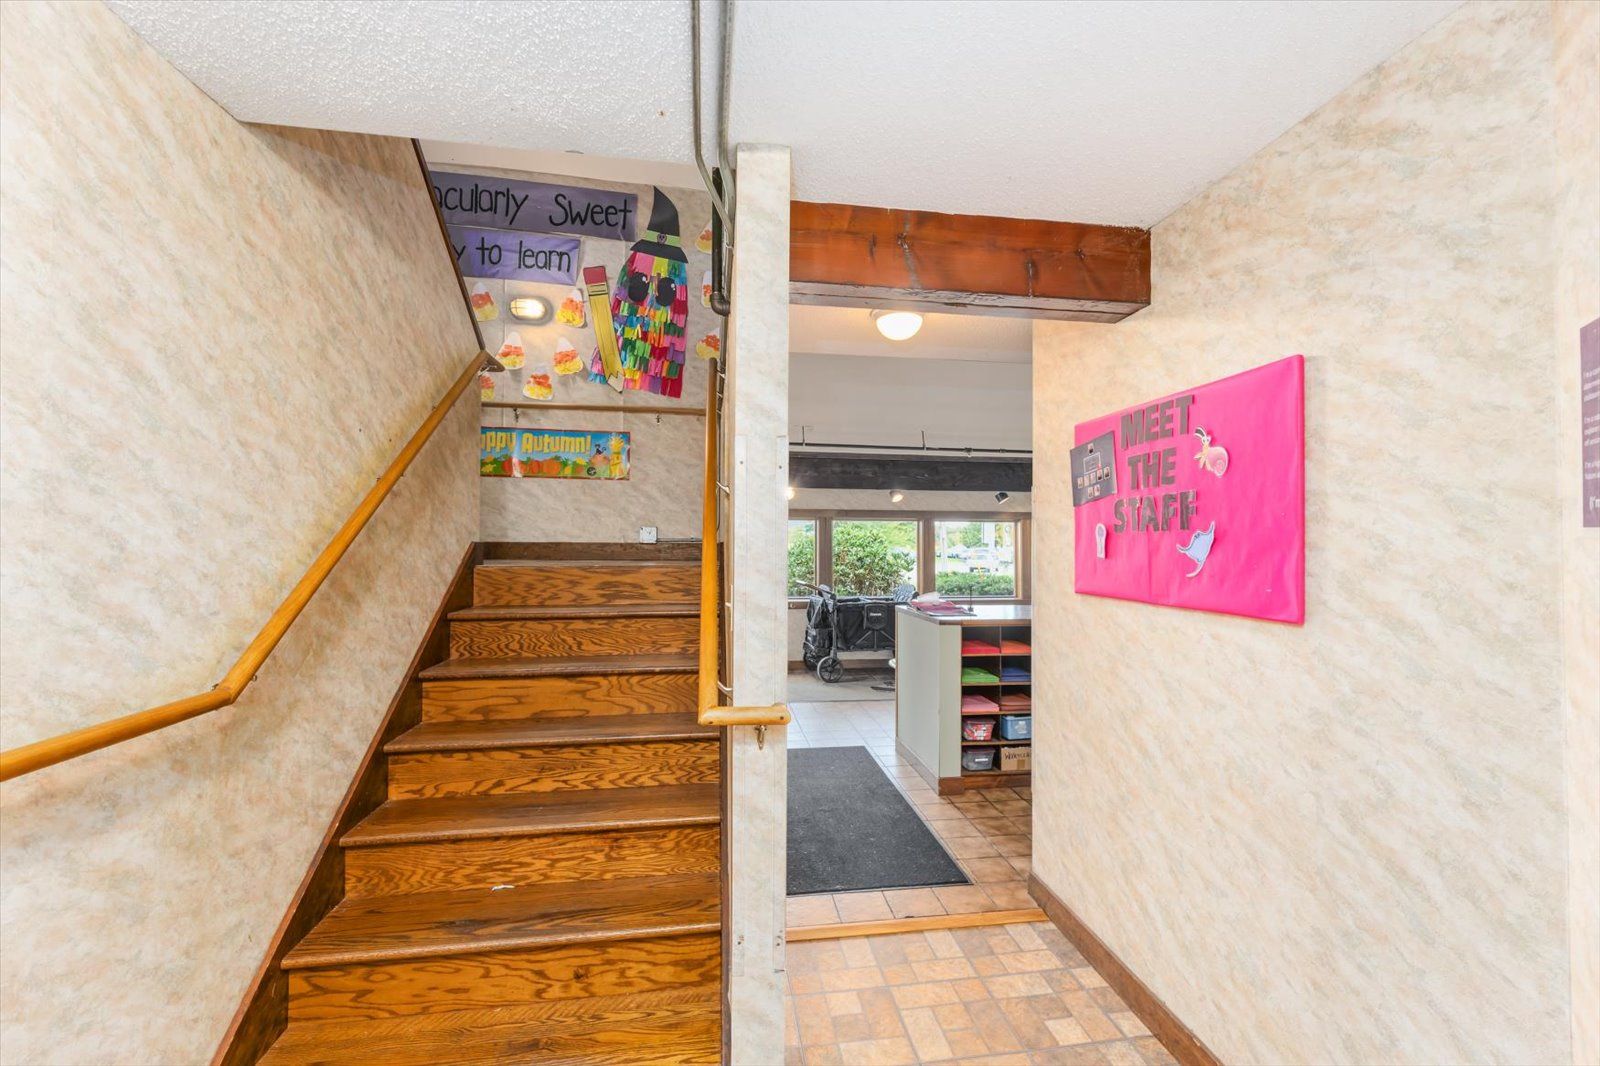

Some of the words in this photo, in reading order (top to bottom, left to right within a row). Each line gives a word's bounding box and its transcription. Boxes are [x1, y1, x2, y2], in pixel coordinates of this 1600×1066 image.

[549, 194, 632, 230] Sweet
[476, 237, 502, 266] to
[517, 240, 571, 272] learn
[1120, 394, 1195, 450] MEET
[521, 433, 592, 454] Autumn!
[1128, 448, 1177, 490] THE
[1113, 490, 1198, 533] STAFF
